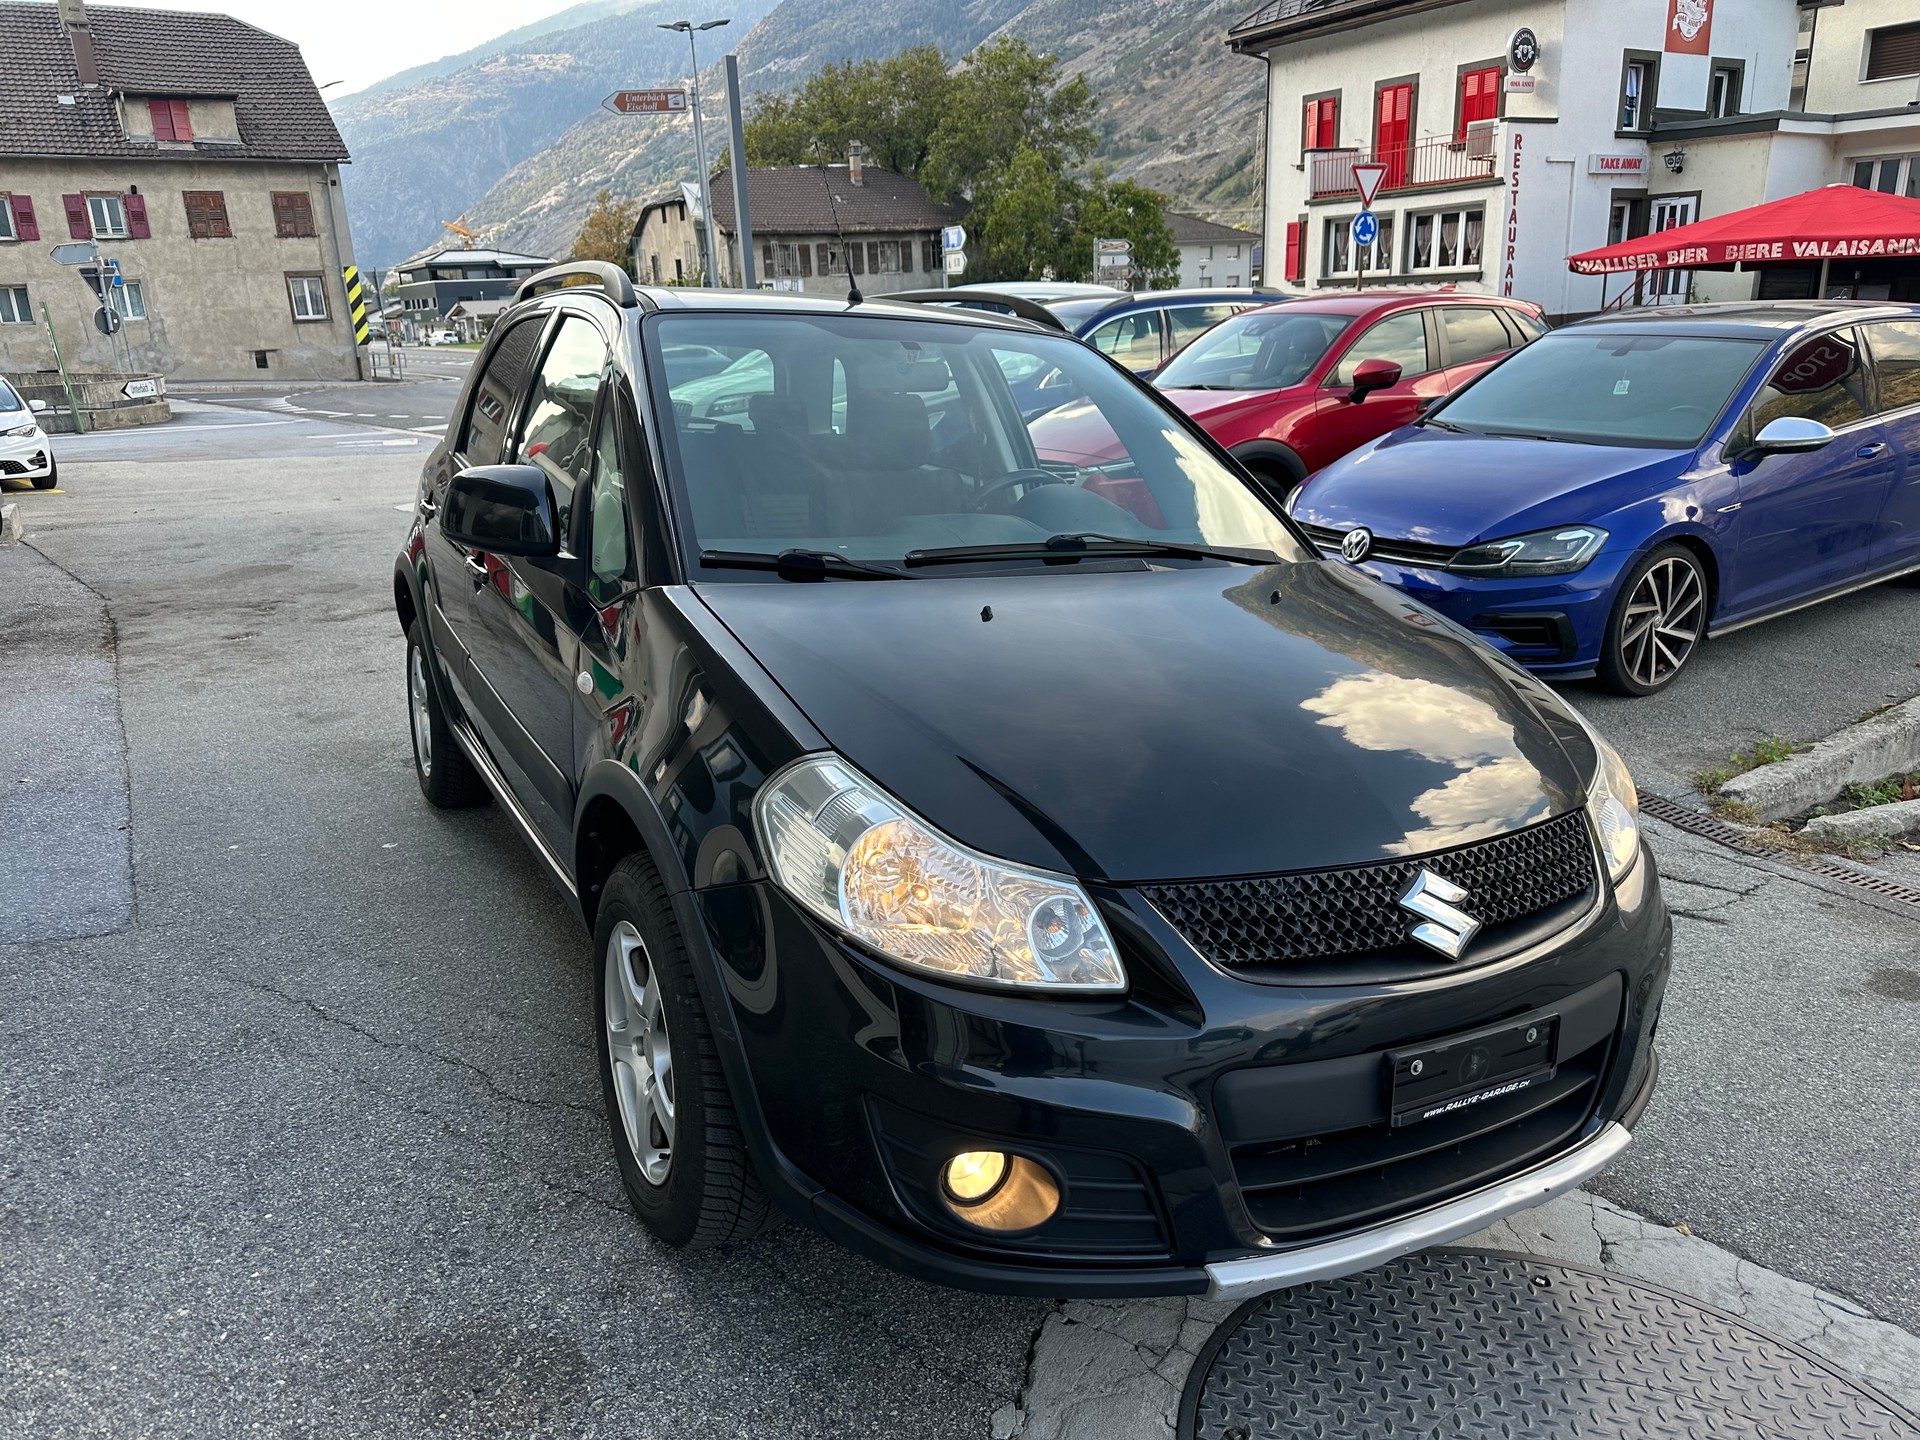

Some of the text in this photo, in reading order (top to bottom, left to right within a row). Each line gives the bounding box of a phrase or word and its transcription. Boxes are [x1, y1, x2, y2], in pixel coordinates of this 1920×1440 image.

[625, 93, 666, 102] Unterbäch
[626, 102, 658, 111] Eischoll
[1600, 157, 1643, 170] TAKE AWAY
[1504, 133, 1523, 296] RESTAURAN
[1576, 253, 1660, 273] WALLISER
[1666, 247, 1709, 265] BIER
[1724, 242, 1784, 260] BIERE
